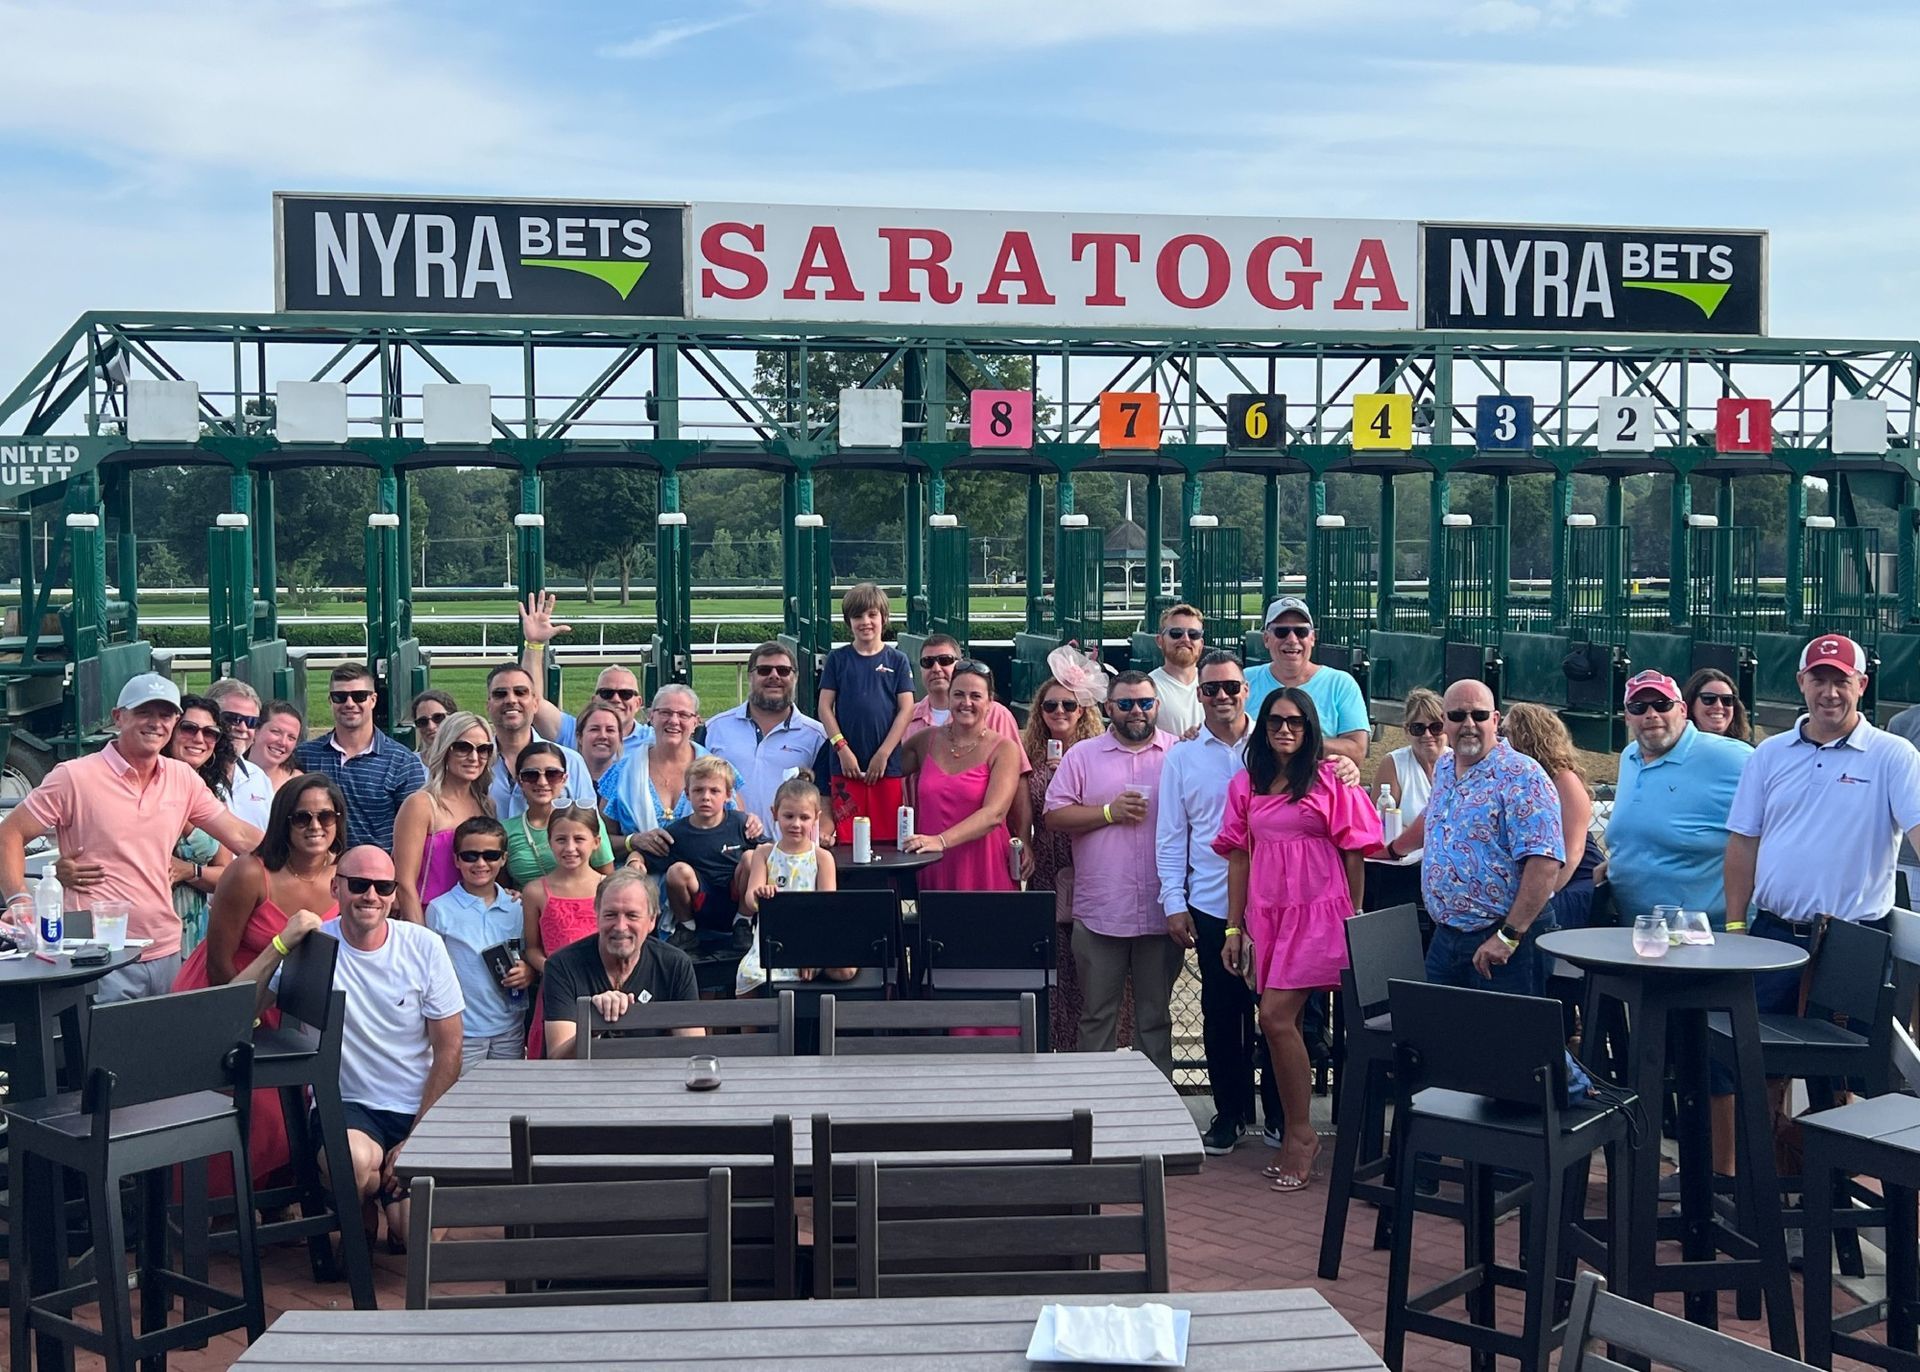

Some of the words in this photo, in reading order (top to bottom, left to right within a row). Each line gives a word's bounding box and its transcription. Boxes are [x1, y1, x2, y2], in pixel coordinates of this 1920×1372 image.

[314, 211, 512, 299] NYRA
[519, 216, 651, 258] BETS
[700, 222, 1408, 310] SARATOGA
[1449, 238, 1615, 318] NYRA
[1622, 243, 1734, 281] BETS
[990, 400, 1013, 438] 8
[1119, 403, 1141, 438] 7
[1245, 403, 1268, 439] 6
[1370, 404, 1392, 439] 4
[1494, 405, 1517, 441] 3
[1616, 407, 1637, 442] 2
[1735, 408, 1751, 443] 1
[0, 446, 80, 464] NITED
[1, 466, 72, 486] UETT
